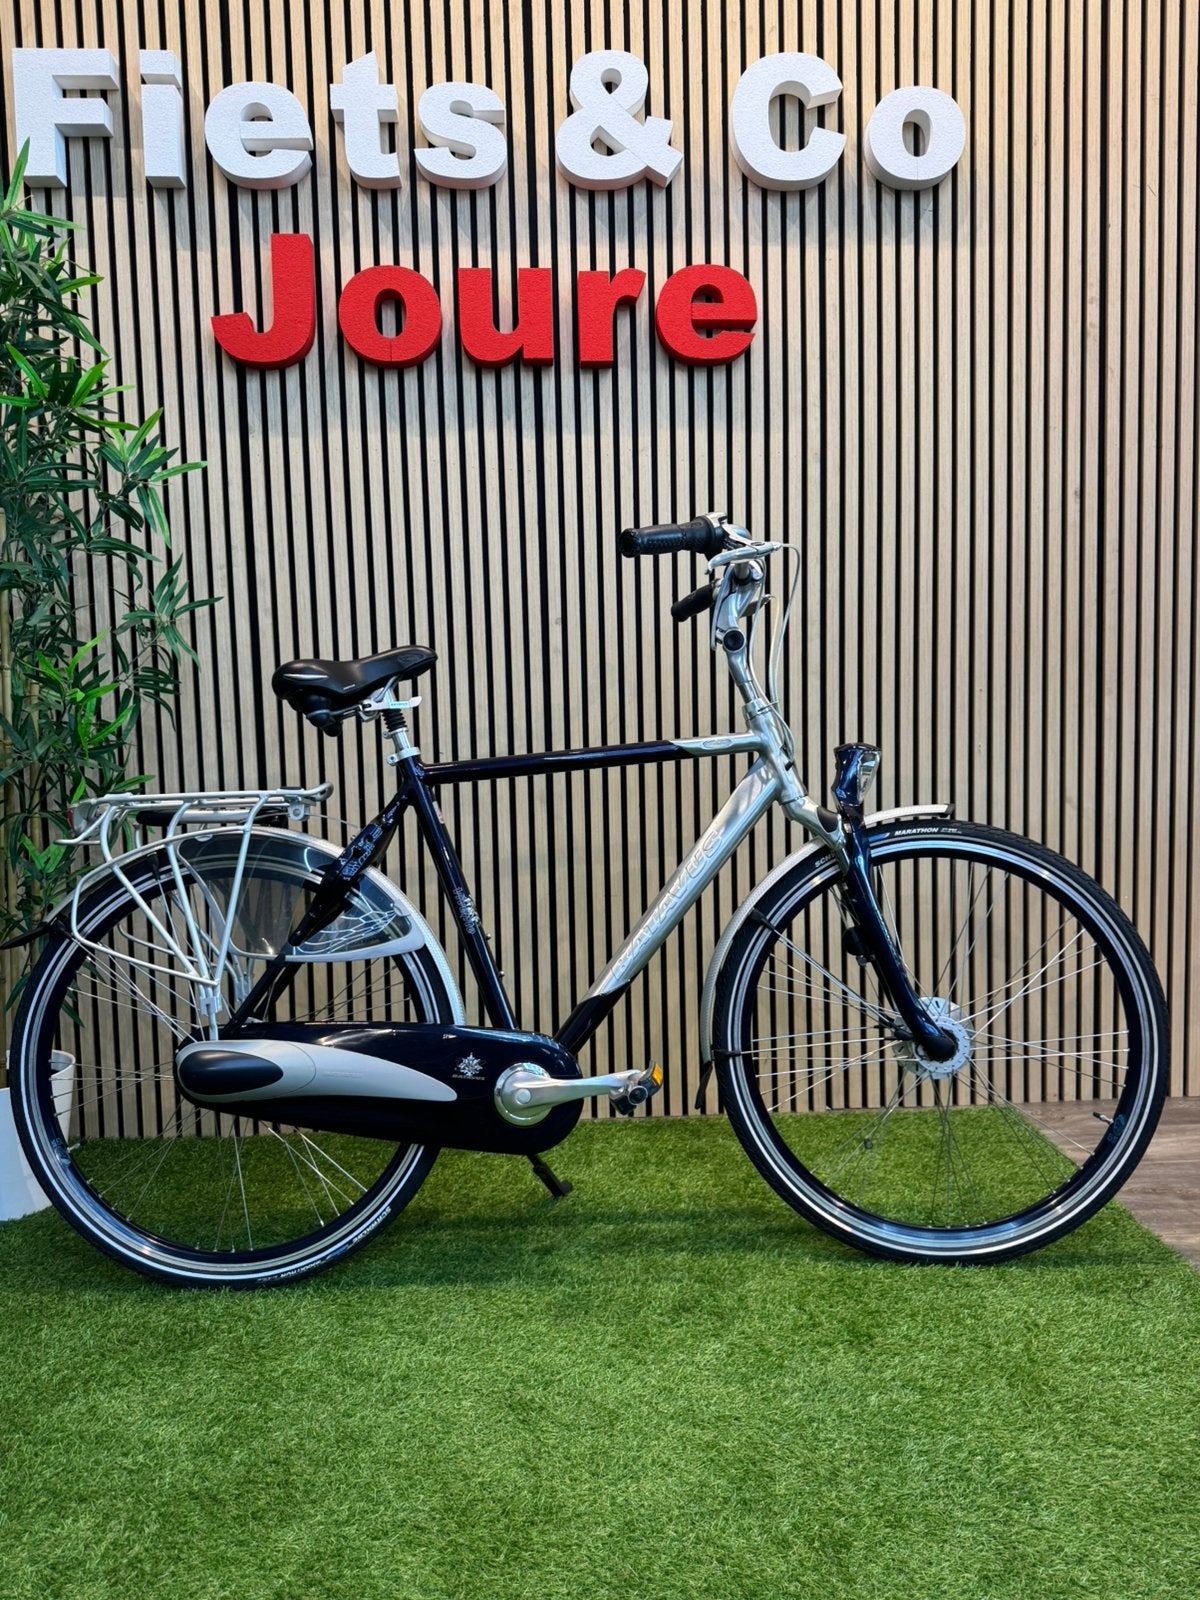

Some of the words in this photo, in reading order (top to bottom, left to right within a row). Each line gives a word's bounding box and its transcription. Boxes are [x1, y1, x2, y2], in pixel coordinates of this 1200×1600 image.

[12, 48, 507, 190] Fiets
[556, 51, 684, 190] &
[733, 52, 967, 191] Co
[212, 233, 758, 367] Joure
[894, 827, 940, 837] MARATHON
[610, 831, 723, 981] BATAVUS
